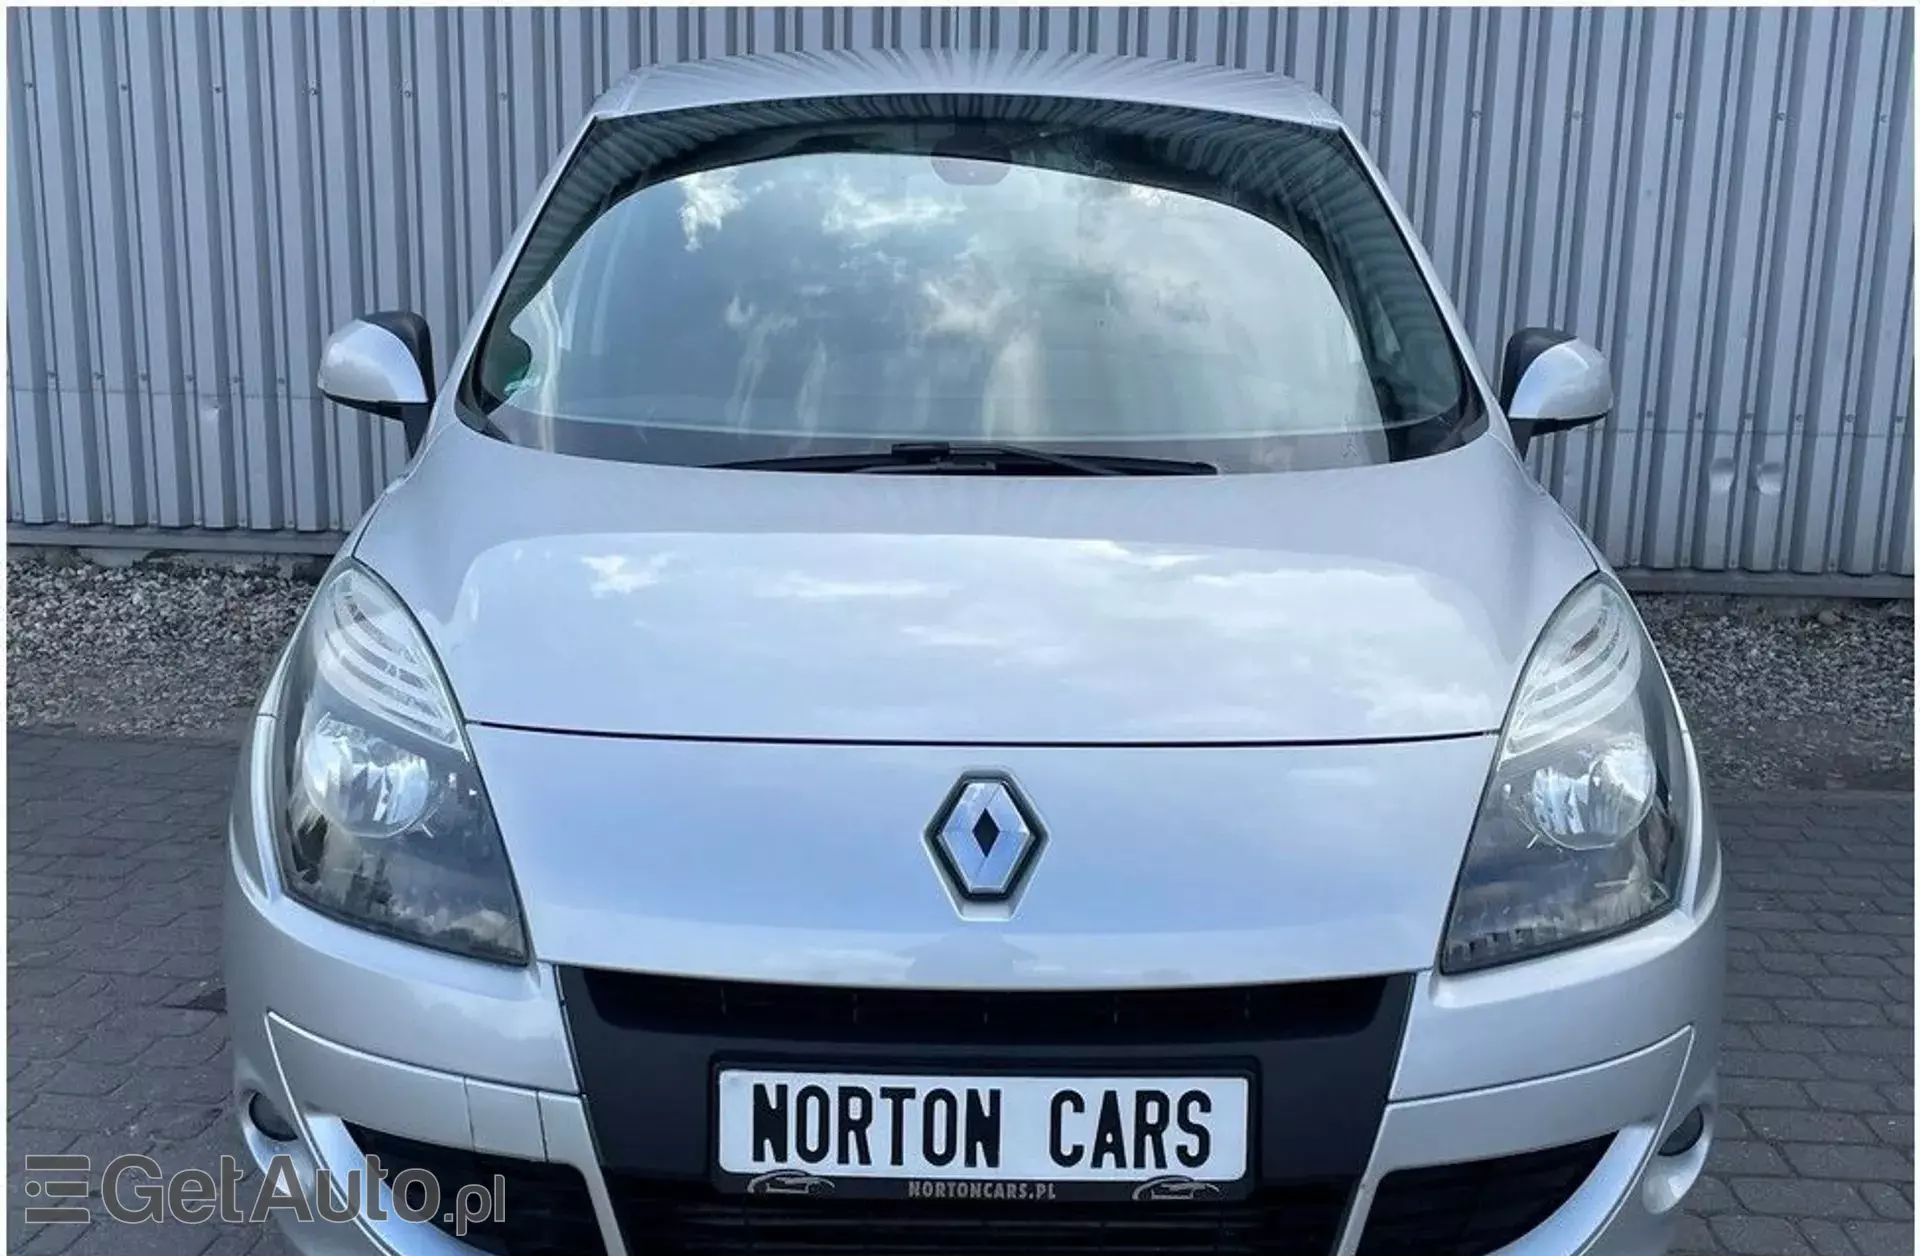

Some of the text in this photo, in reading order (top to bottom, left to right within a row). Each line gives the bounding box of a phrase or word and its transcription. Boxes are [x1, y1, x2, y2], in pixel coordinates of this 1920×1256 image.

[752, 1083, 1212, 1169] NORTON CARS
[908, 1179, 1057, 1201] NORTONCARS.PL
